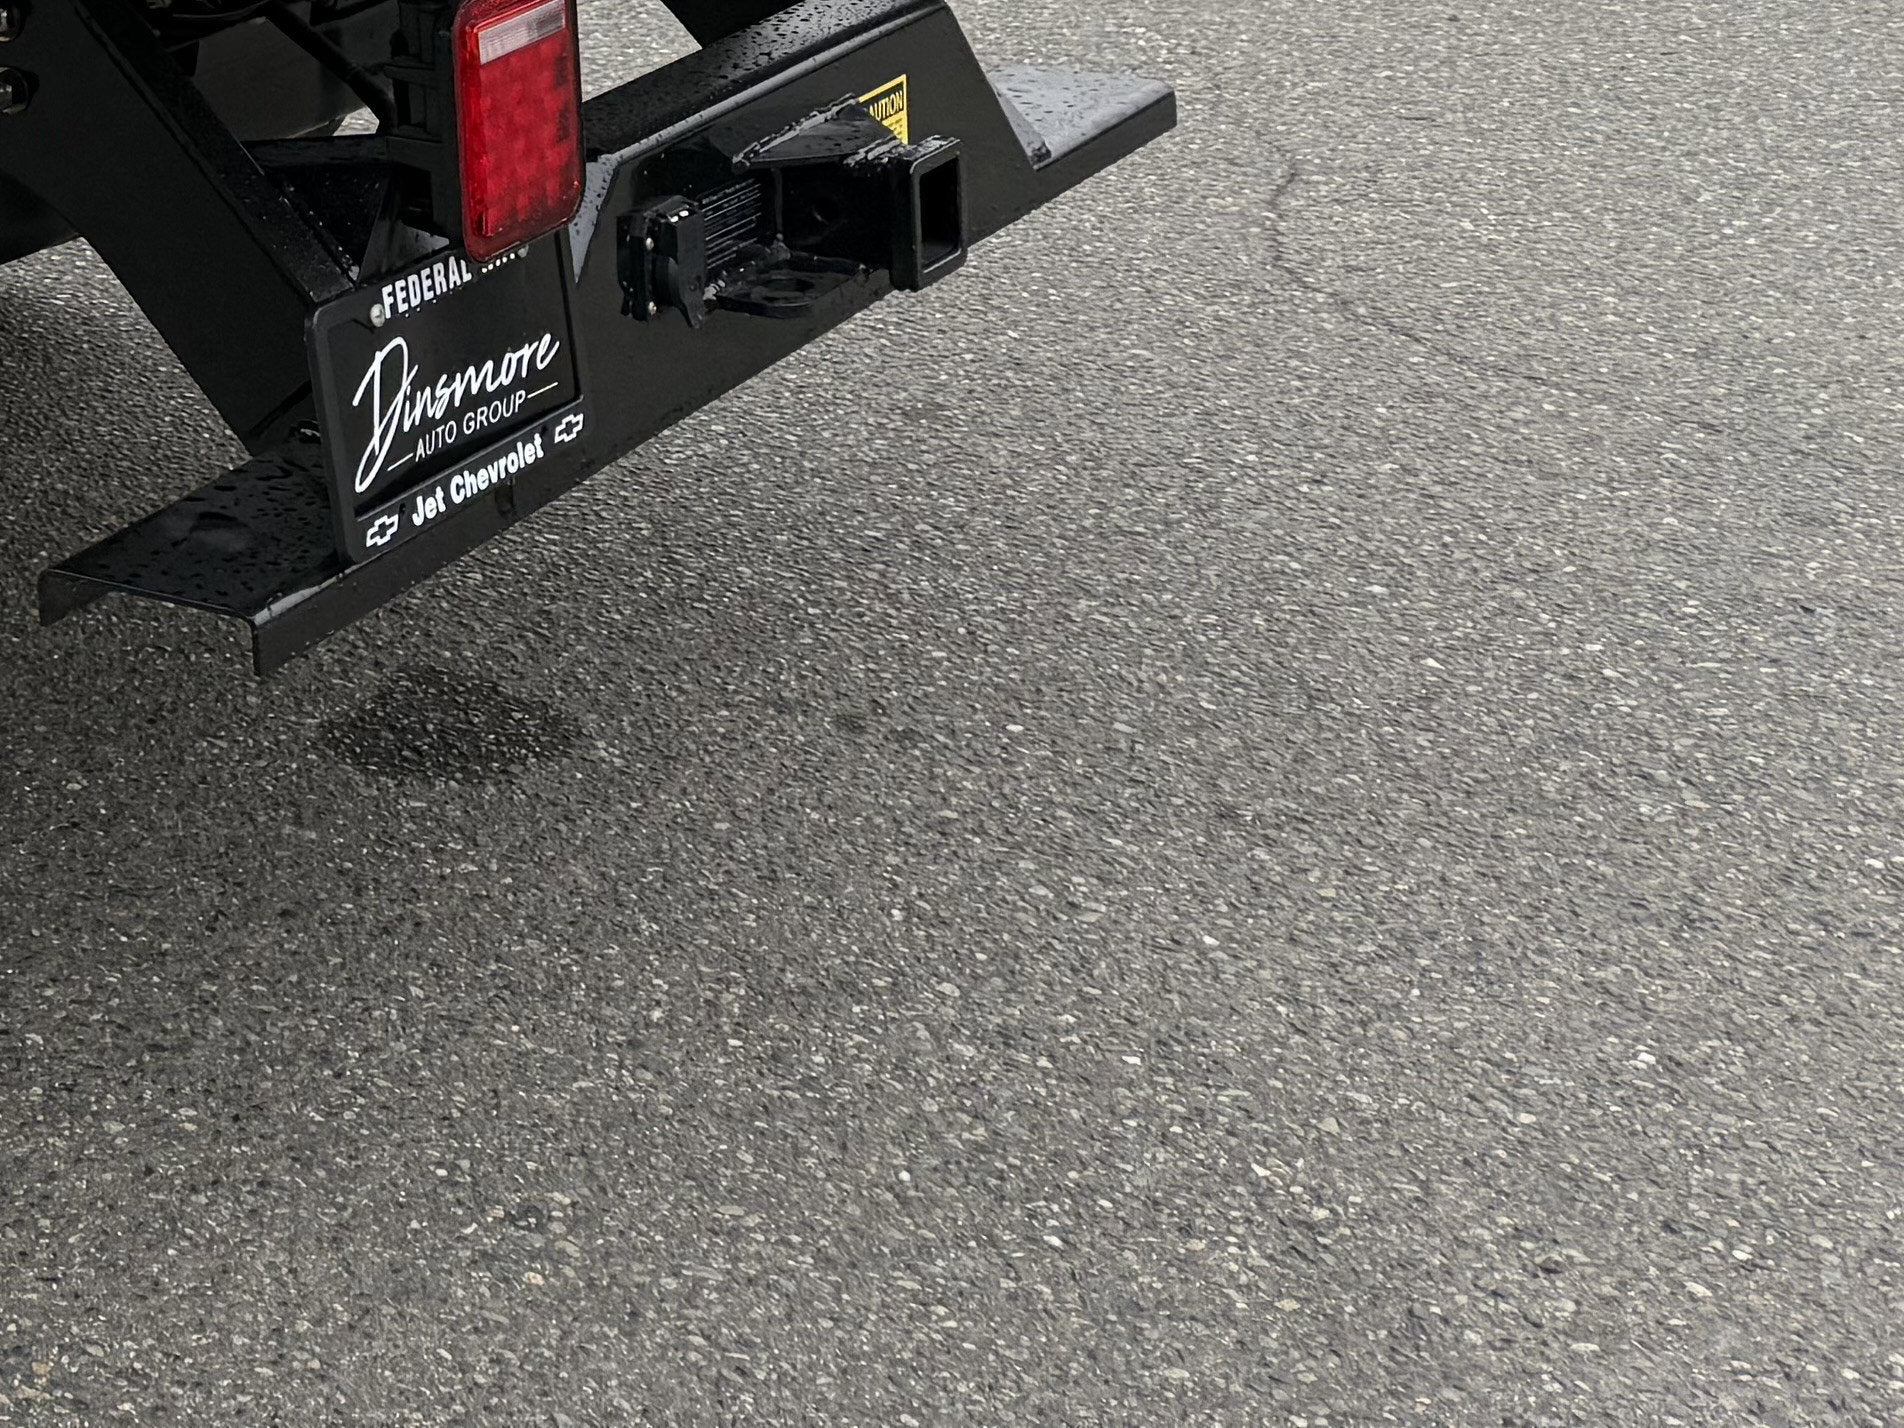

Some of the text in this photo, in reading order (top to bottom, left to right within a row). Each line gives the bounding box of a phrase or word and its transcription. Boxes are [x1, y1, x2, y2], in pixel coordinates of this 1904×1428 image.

[868, 89, 903, 121] AUTION
[381, 255, 472, 319] FEDERAL
[352, 333, 560, 493] Dinsmore
[414, 390, 526, 463] AUTO GROUP
[412, 433, 544, 527] Jet Chevrolet
